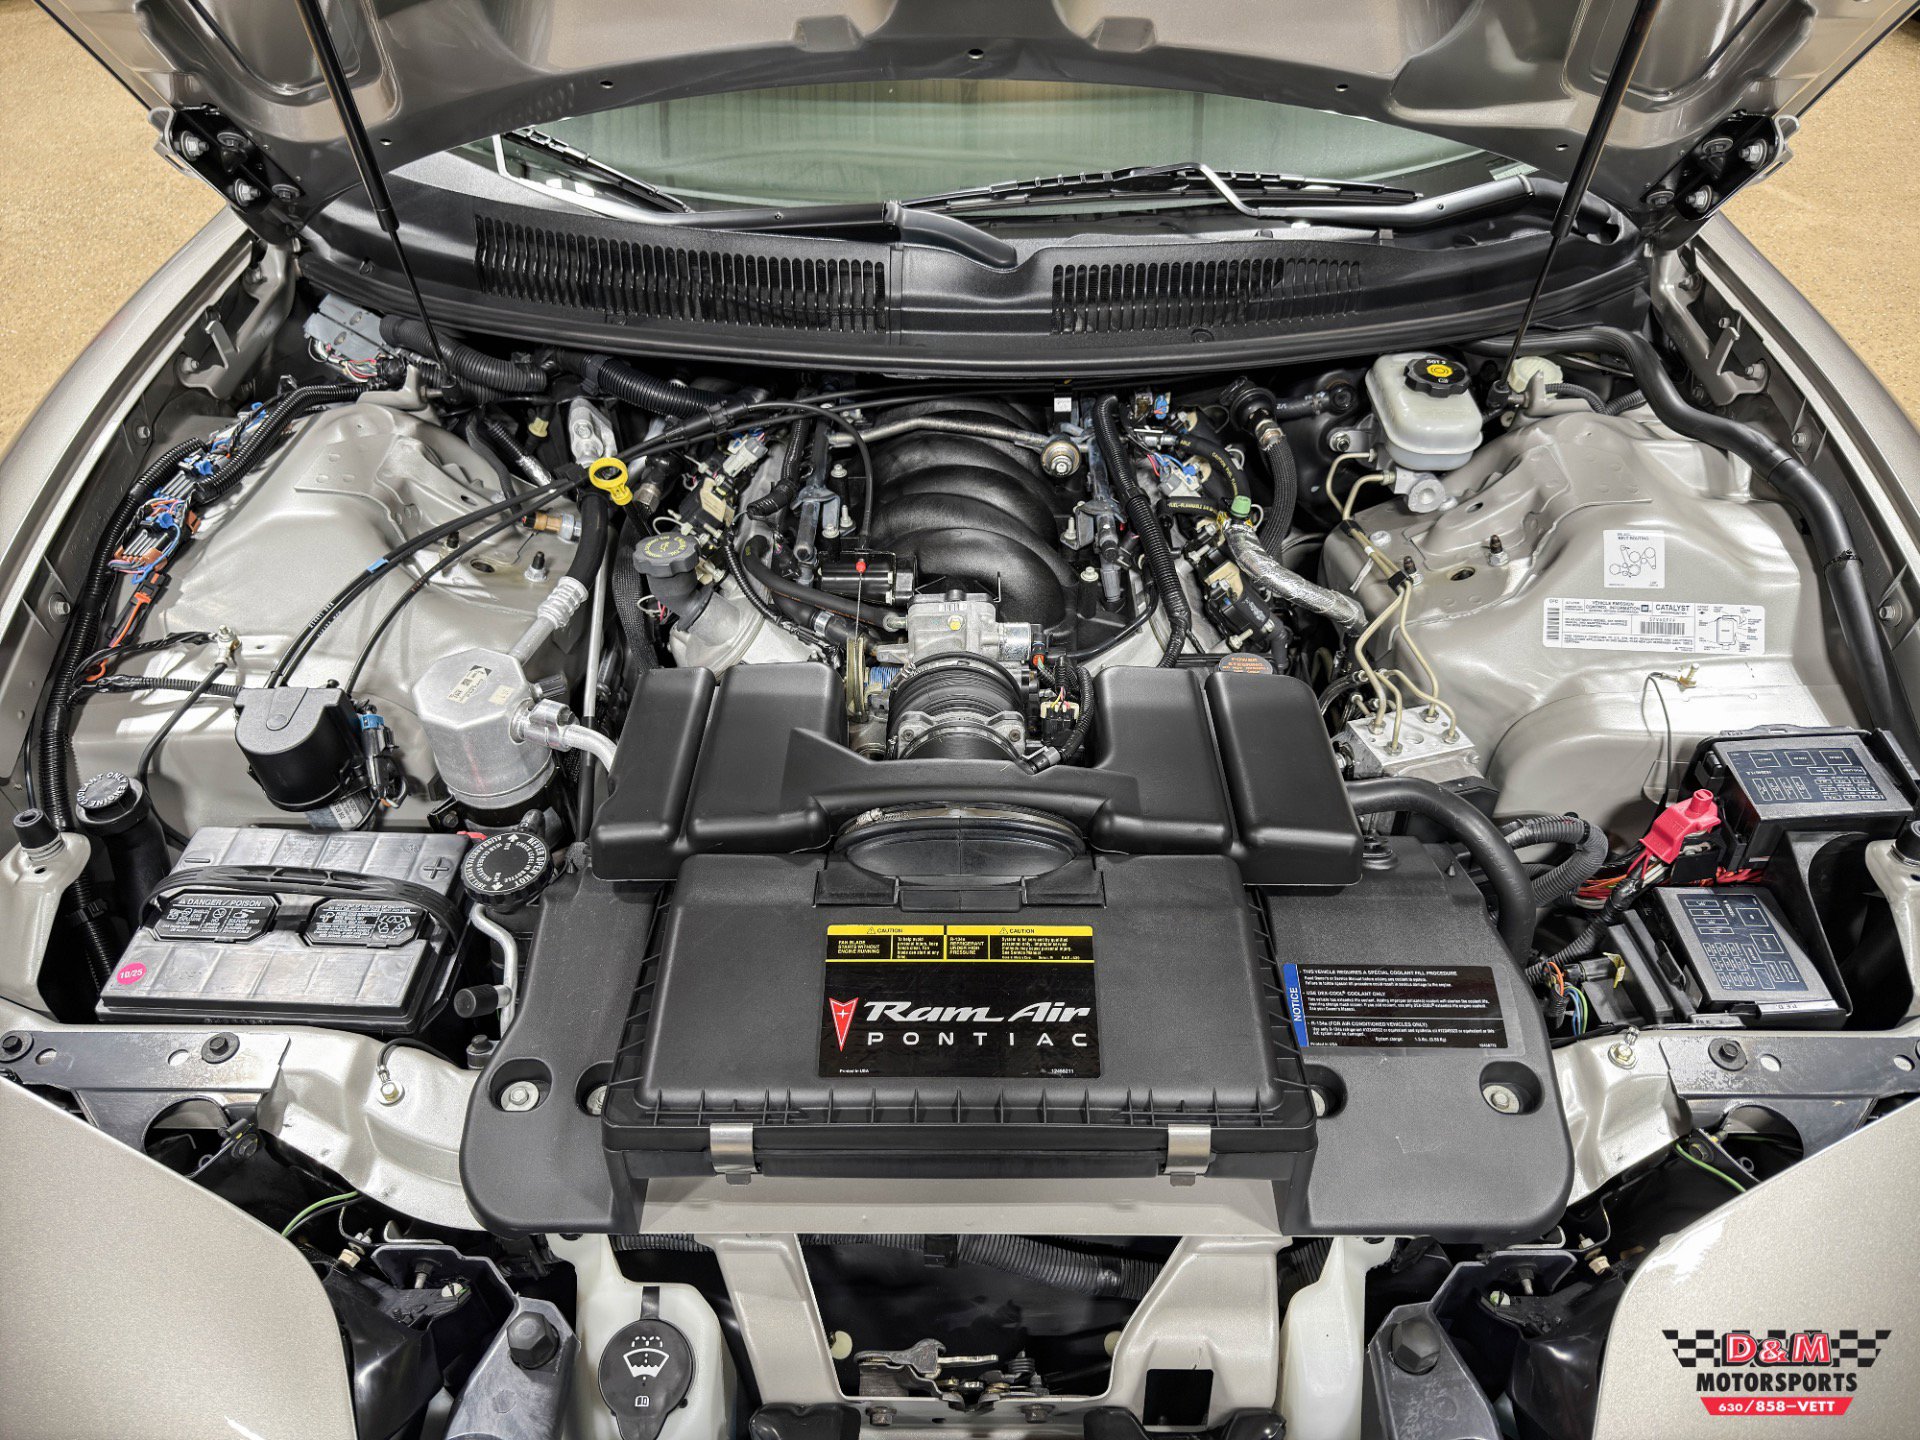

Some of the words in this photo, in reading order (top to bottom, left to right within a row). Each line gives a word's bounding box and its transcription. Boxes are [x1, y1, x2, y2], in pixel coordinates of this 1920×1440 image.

[527, 837, 544, 855] NEVER
[530, 857, 545, 873] OPEN
[515, 874, 532, 887] HOT
[120, 969, 143, 978] 10/25
[864, 1001, 1004, 1022] Ram
[1007, 1002, 1091, 1022] Air
[1290, 987, 1302, 1022] NOTICE
[867, 1032, 1088, 1046] PONTIAC
